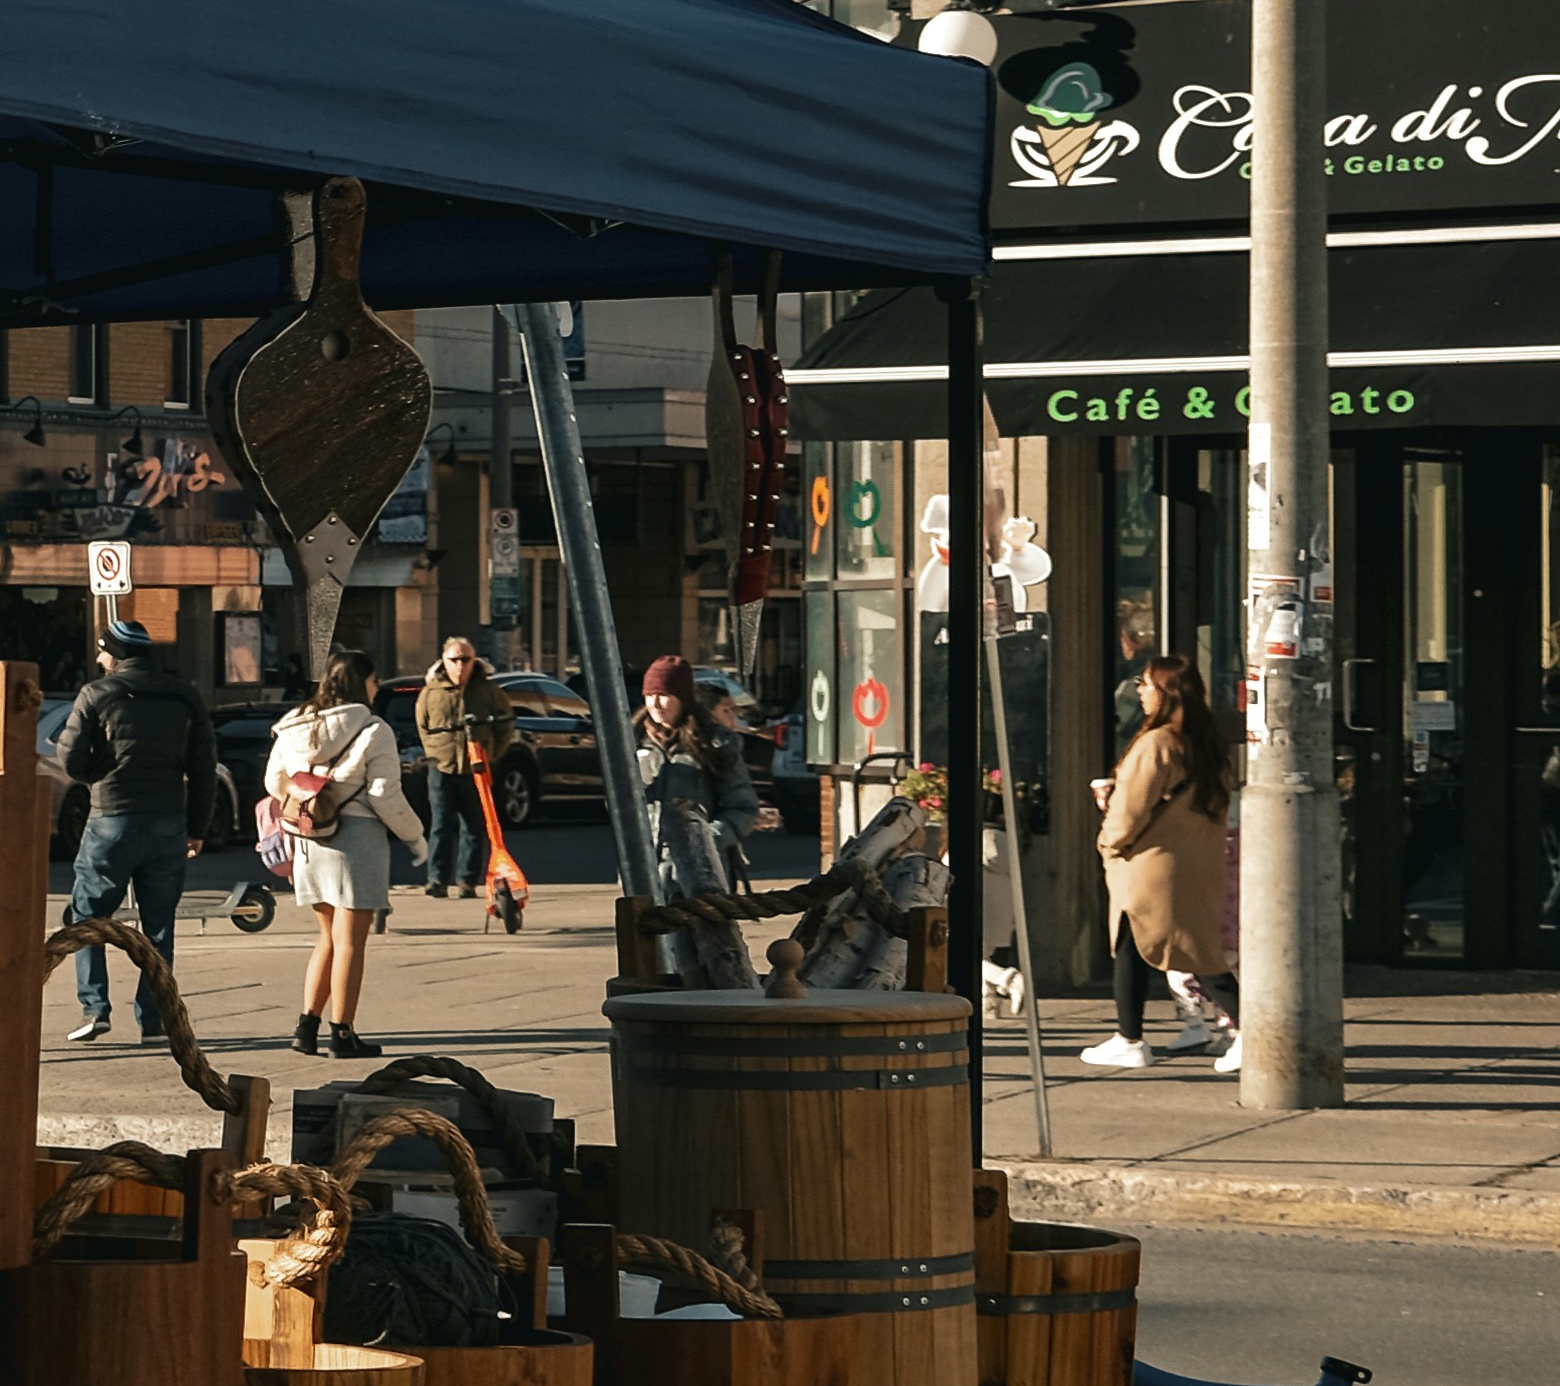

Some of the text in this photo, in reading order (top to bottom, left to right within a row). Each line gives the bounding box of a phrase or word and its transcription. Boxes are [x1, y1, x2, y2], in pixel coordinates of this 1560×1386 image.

[1158, 84, 1378, 180] Ca
[1390, 84, 1481, 143] di
[1343, 154, 1445, 176] Gelato
[1046, 385, 1416, 422] Café & ato
